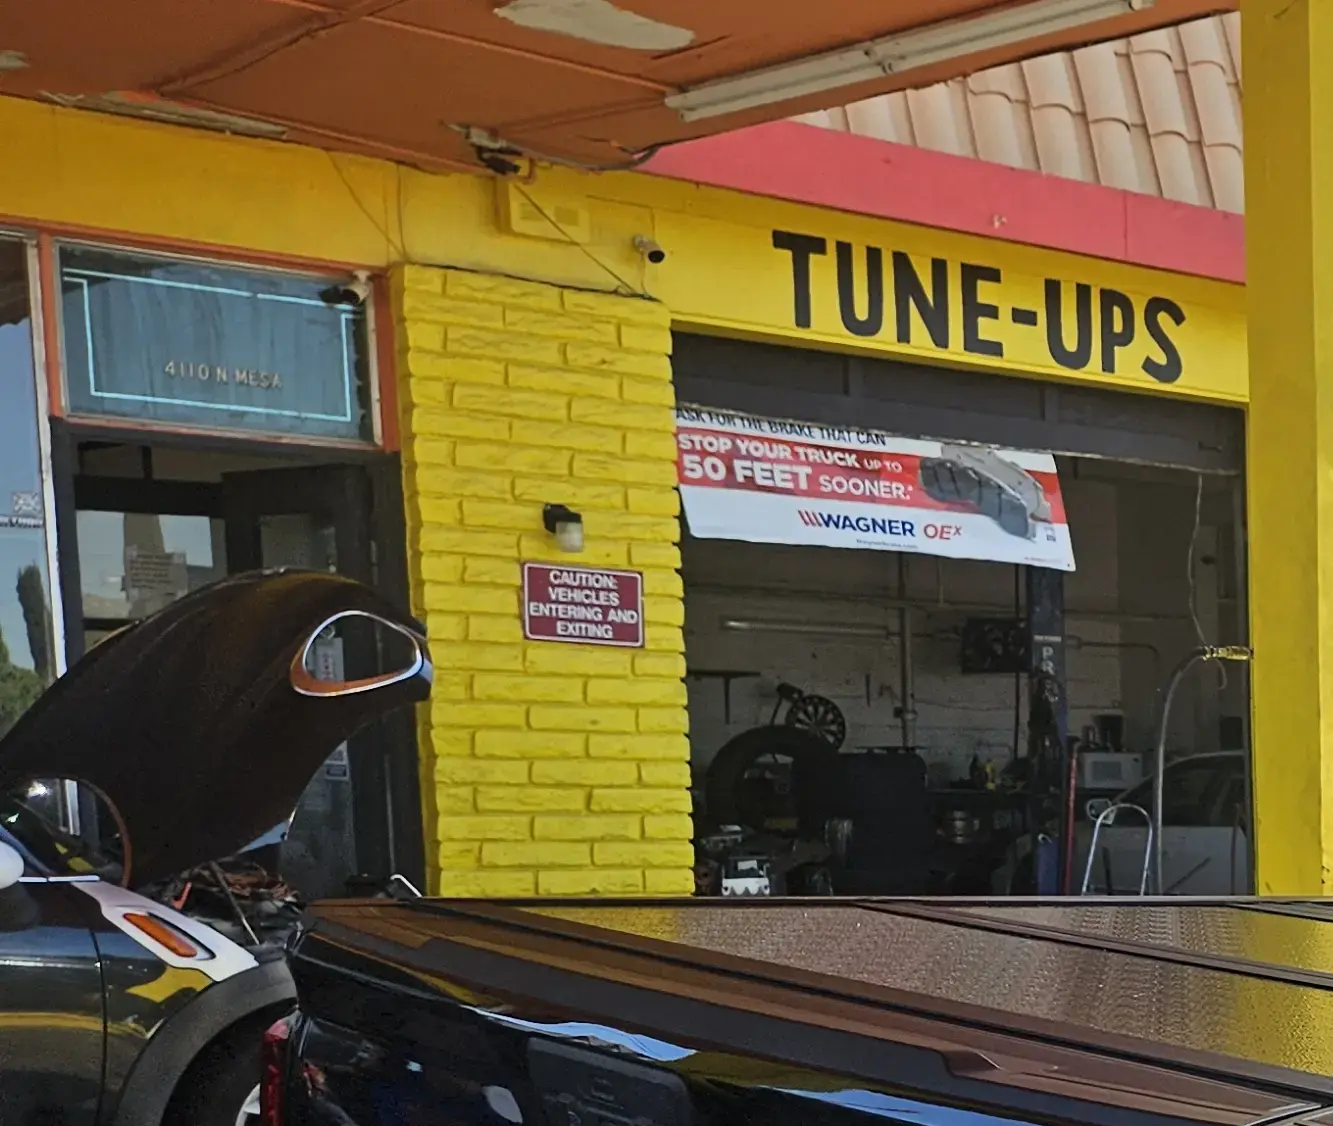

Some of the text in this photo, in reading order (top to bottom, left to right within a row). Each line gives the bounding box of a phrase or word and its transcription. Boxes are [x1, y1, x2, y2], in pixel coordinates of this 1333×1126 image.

[772, 229, 1186, 384] TUNE-UPS
[165, 360, 282, 389] 4110 N MESA
[856, 431, 886, 447] CAN
[678, 433, 903, 473] STOP YOUR TRUCK UP TO
[682, 453, 727, 481] 50
[733, 459, 812, 490] FEET
[819, 512, 916, 538] WAGNER
[548, 586, 619, 607] VEHICLES
[529, 602, 638, 624] ENTERING AND
[556, 620, 613, 638] EXITING
